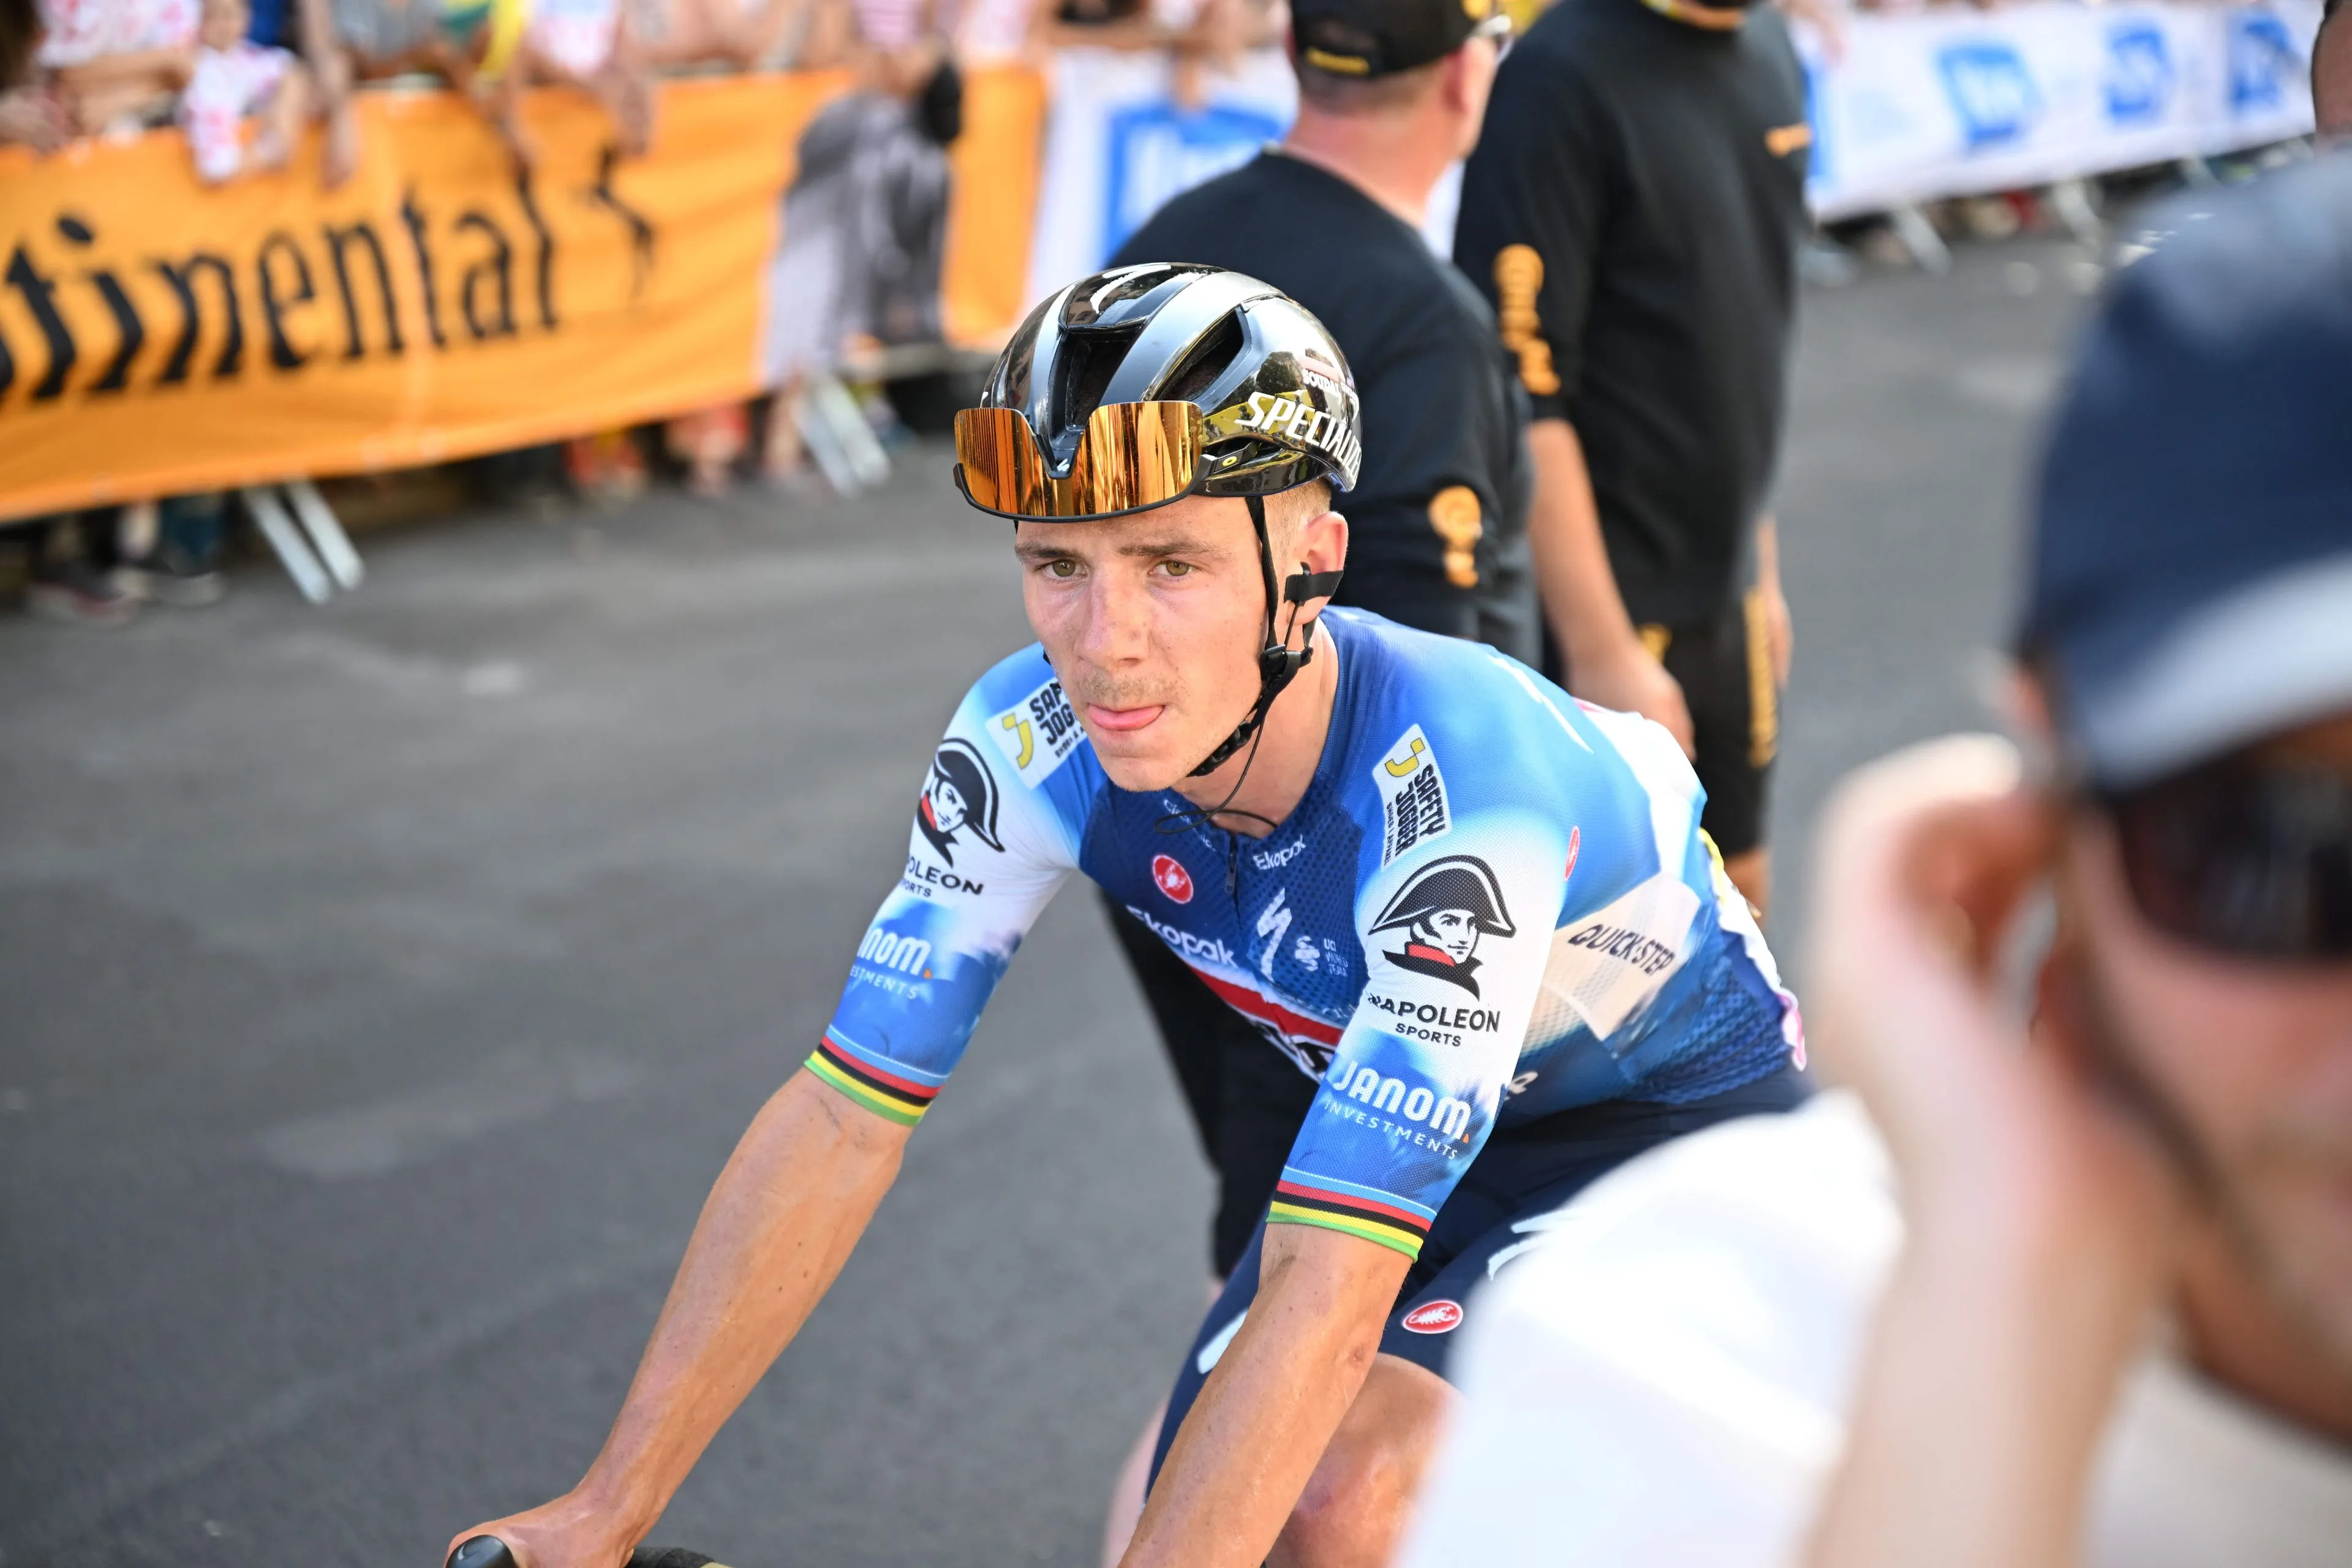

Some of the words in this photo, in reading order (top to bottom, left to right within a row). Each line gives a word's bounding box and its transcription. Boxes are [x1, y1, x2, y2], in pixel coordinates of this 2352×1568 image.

[0, 167, 558, 405] tinental
[1235, 391, 1362, 484] SPECIALIZE
[1029, 682, 1063, 722] SAF
[1039, 703, 1076, 746] JOG
[1395, 781, 1419, 858] JOGGER
[1414, 763, 1446, 838] SAFETY
[908, 856, 984, 895] OLEON
[1395, 1023, 1462, 1047] SPORTS
[1324, 1099, 1458, 1160] INVESTMENTS
